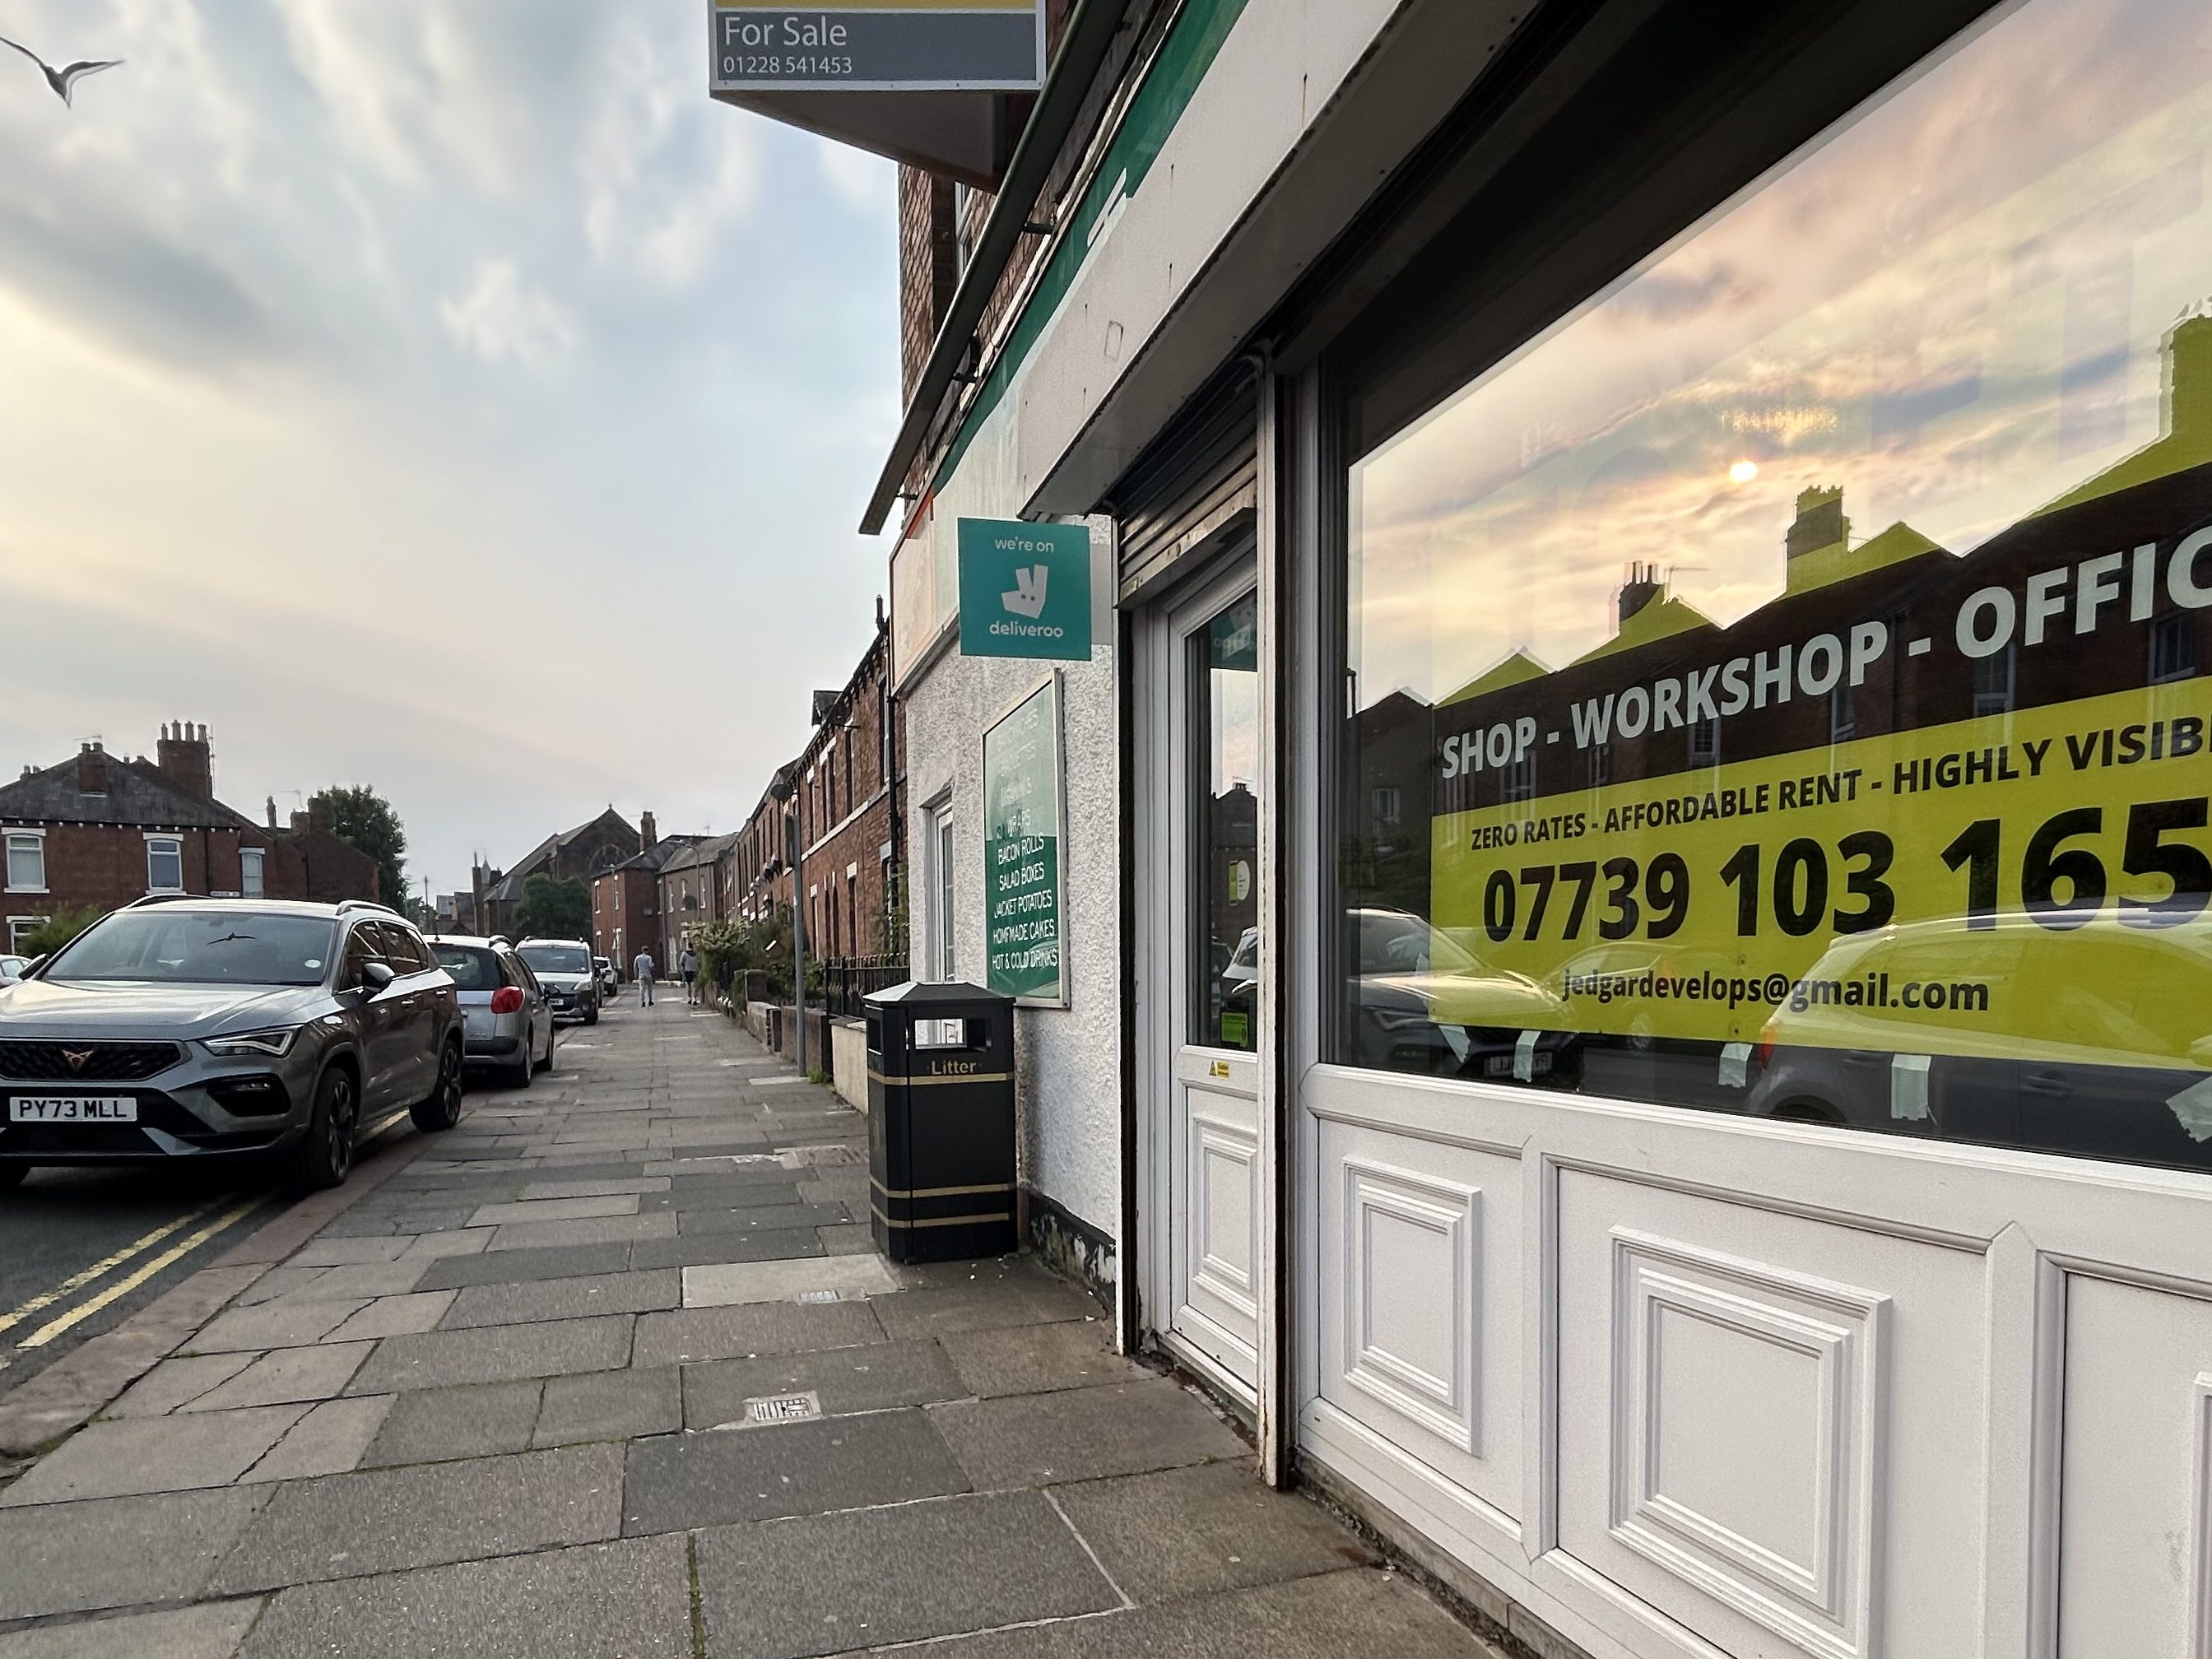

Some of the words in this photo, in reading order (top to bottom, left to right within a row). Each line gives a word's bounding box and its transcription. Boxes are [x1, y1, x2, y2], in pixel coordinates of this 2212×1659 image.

[725, 16, 774, 46] For
[783, 16, 847, 46] Sale
[723, 56, 780, 73] 01228
[786, 57, 853, 74] 541453
[994, 537, 1033, 551] we're
[1036, 541, 1053, 552] on
[989, 620, 1063, 638] deliveroo
[1443, 717, 1536, 778] SHOP
[1570, 620, 1889, 750] WORKSHOP
[1471, 823, 1517, 850] ZERO
[1523, 813, 1585, 843] RATES
[1604, 783, 1769, 834] AFFORDABLE
[1779, 769, 1862, 810] RENT
[1894, 738, 2053, 795] HIGHLY
[2065, 716, 2212, 770] VISIB
[998, 842, 1020, 865] BACON
[1021, 832, 1044, 856] ROLLS
[999, 870, 1020, 891] SALAD
[1021, 862, 1044, 885] BOXES
[1484, 852, 1689, 942] 07739
[1719, 830, 1895, 936] 103
[1940, 796, 2212, 932] 165
[994, 898, 1017, 918] JACKET
[1018, 889, 1053, 913] POTATOES
[993, 923, 1028, 944] HOMEMADE
[1029, 918, 1054, 939] CAKES
[992, 954, 1004, 969] HOT
[1011, 951, 1029, 969] COLD
[1030, 948, 1057, 968] DRINKS
[1562, 969, 1988, 1013] jedgardevelops@gmail.com
[932, 1061, 976, 1075] Litter
[19, 1100, 77, 1118] PY73
[84, 1100, 127, 1118] MLL
